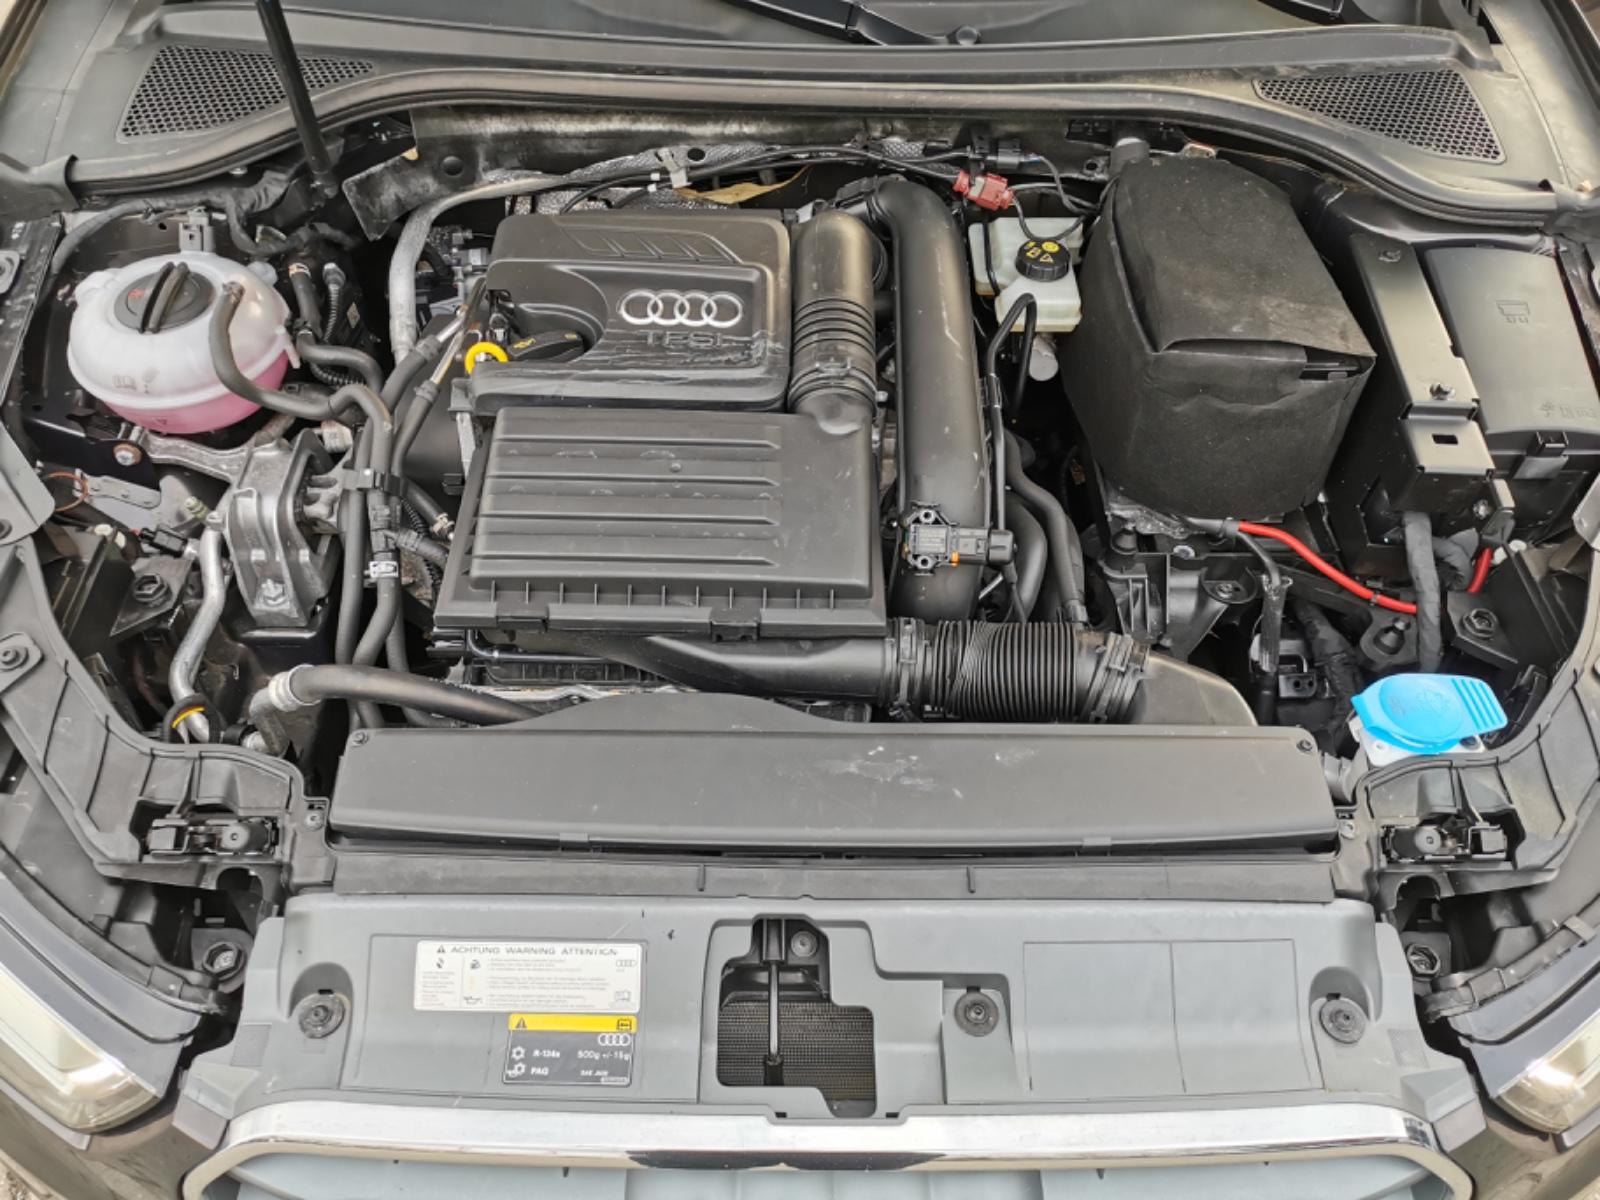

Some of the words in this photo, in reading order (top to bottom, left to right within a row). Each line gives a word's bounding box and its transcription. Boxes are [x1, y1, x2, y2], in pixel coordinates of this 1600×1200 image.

[450, 946, 500, 955] ACHTUNG
[505, 947, 556, 956] WARNING
[561, 947, 618, 957] ATTENTION
[530, 1067, 549, 1076] PAG
